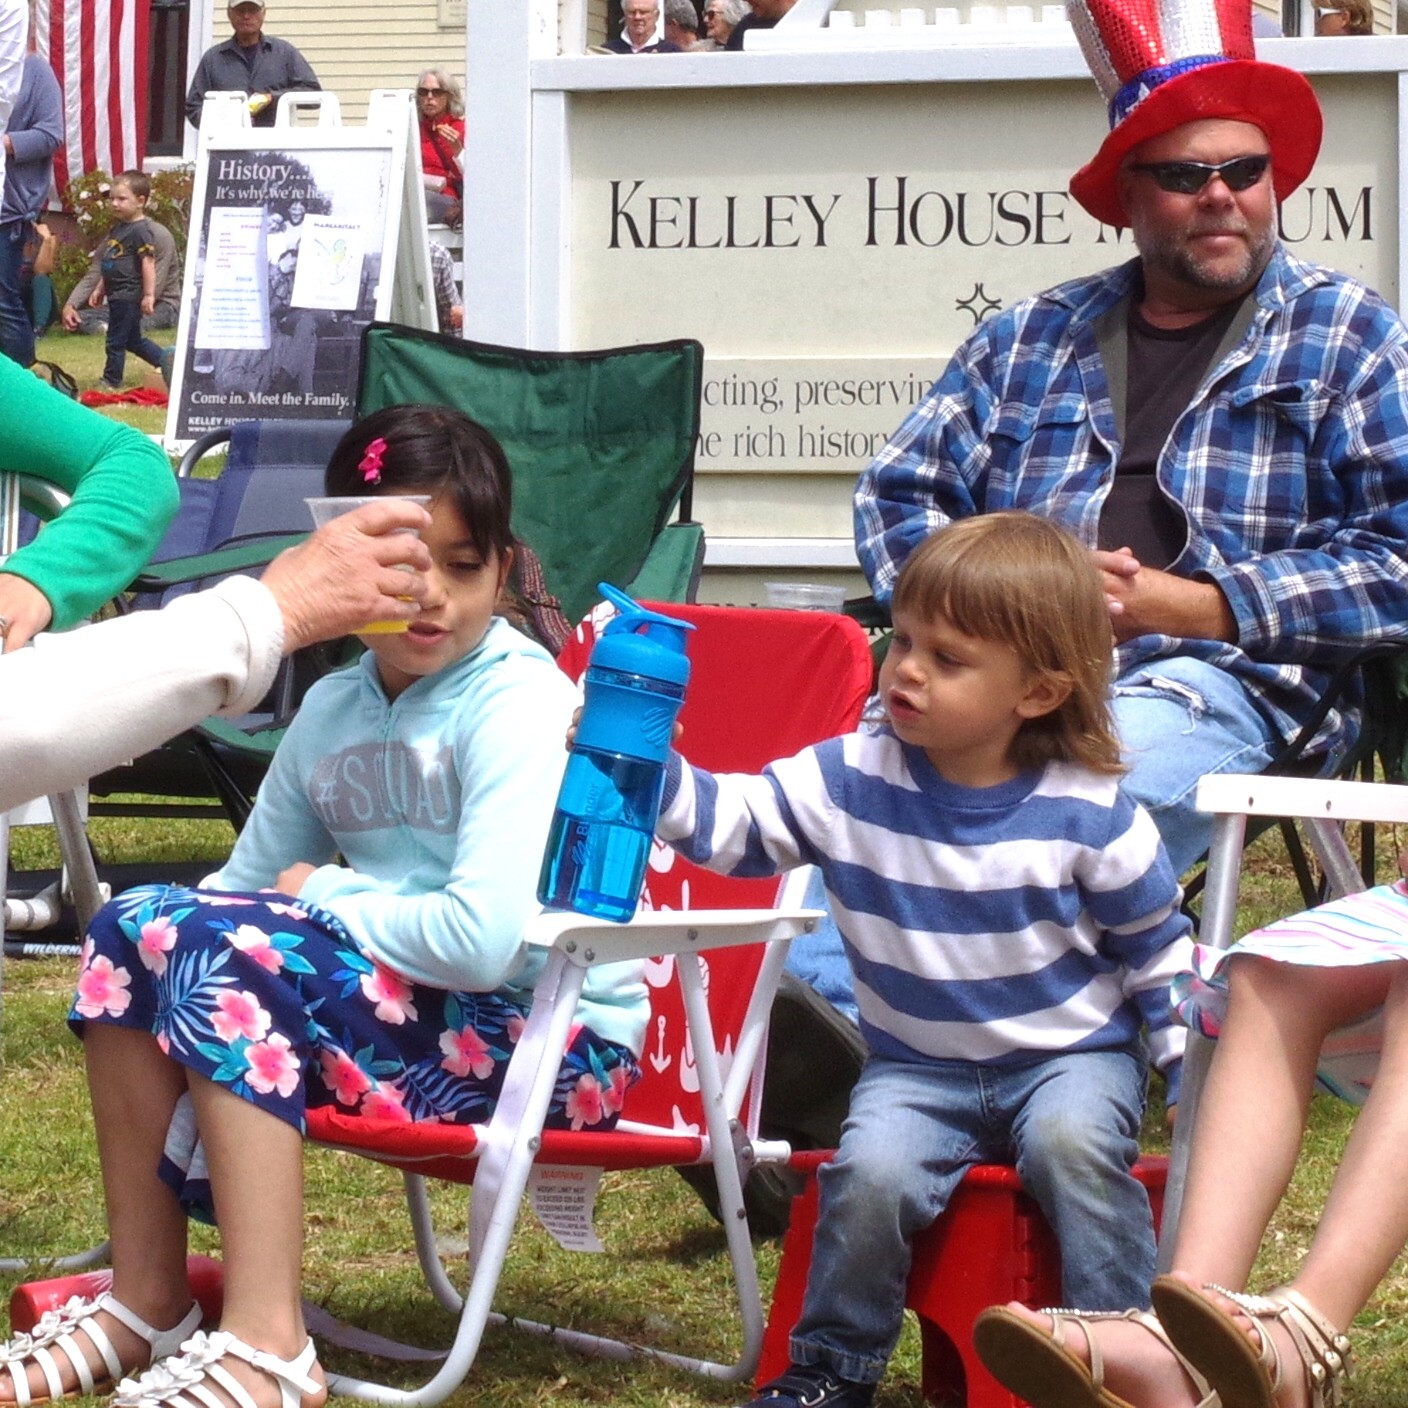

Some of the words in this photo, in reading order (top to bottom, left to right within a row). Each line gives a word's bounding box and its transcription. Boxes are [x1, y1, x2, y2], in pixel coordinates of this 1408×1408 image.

[216, 185, 235, 200] It's
[606, 180, 842, 249] KELLEY
[864, 176, 1072, 247] HOUSE
[191, 391, 227, 405] Come
[229, 392, 245, 405] in.
[248, 392, 280, 405] Meet
[282, 392, 303, 405] the
[304, 393, 350, 410] Family.
[188, 416, 222, 425] KELLEY
[733, 424, 786, 457] rich
[576, 784, 599, 837] Blnder
